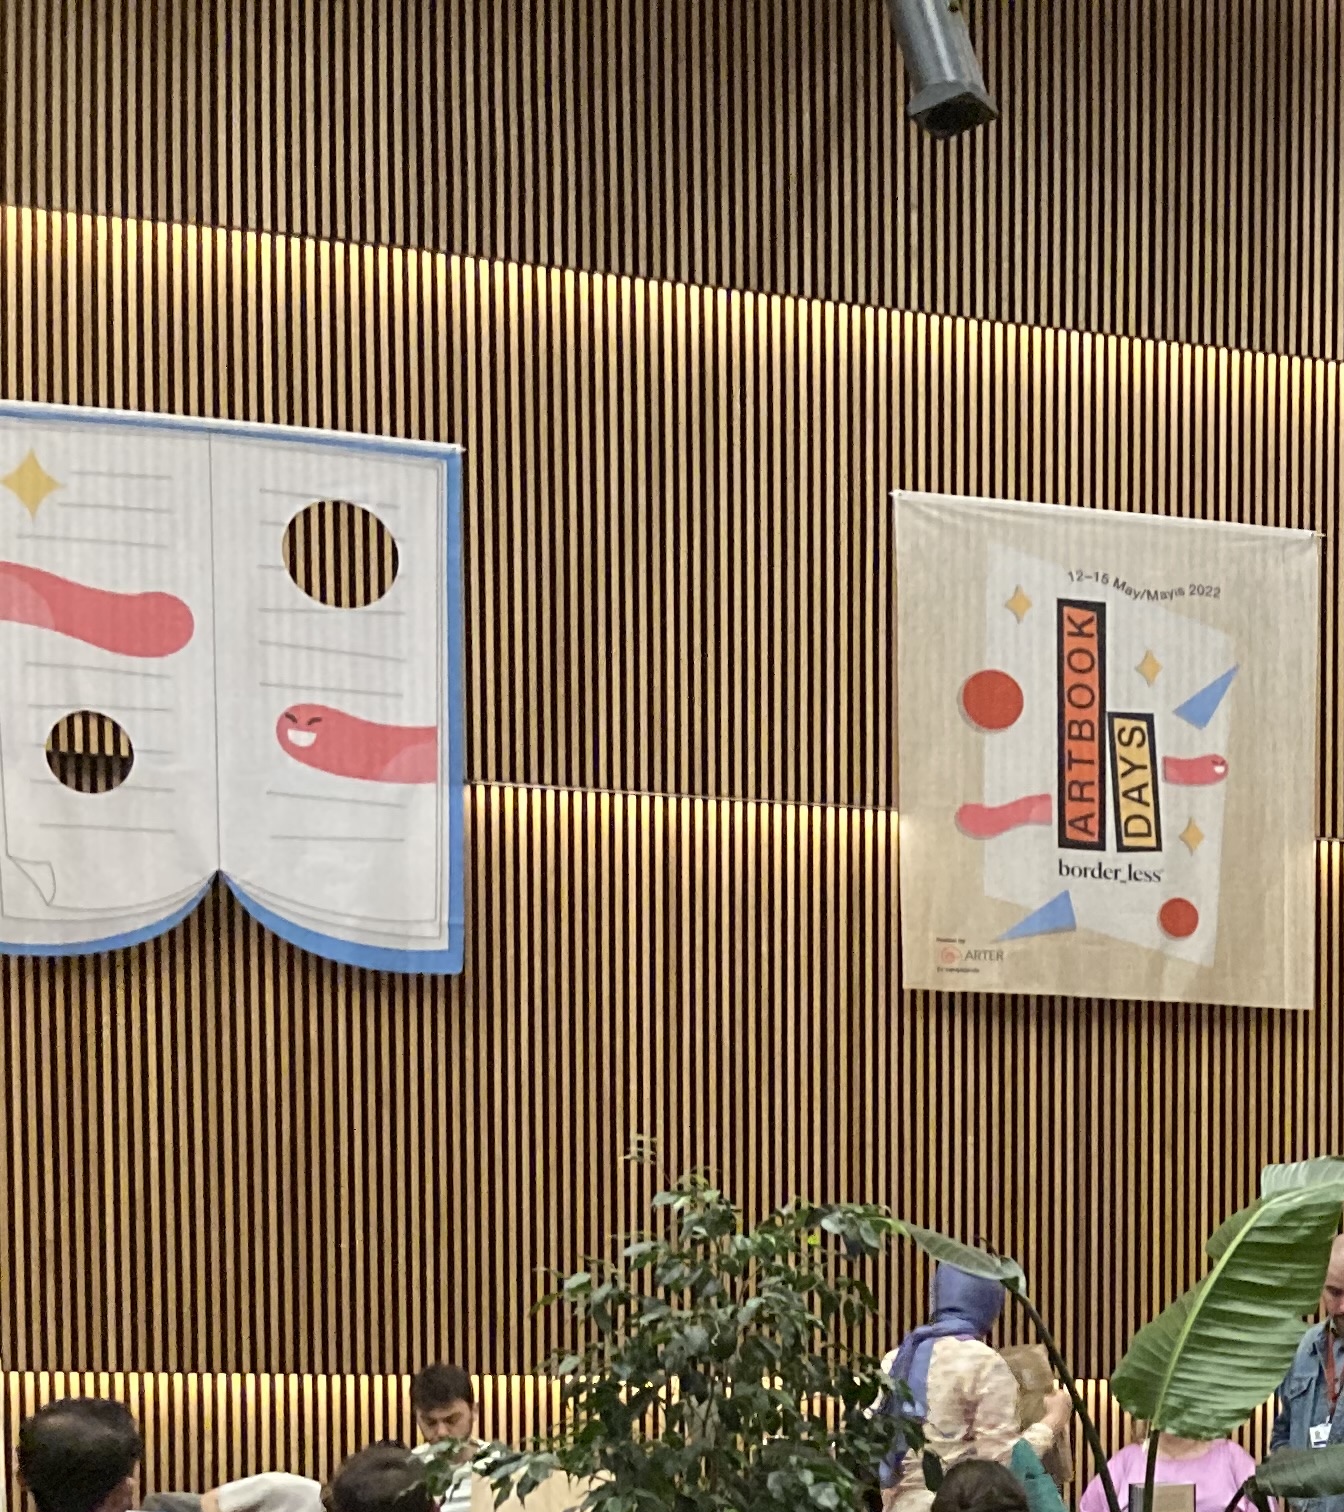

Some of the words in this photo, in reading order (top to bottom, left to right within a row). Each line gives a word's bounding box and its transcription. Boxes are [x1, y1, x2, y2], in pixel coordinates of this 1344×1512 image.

[1188, 583, 1221, 599] 2022
[1065, 613, 1097, 837] ARTBOOK
[1117, 724, 1152, 839] DAYS
[1058, 858, 1162, 883] border_less
